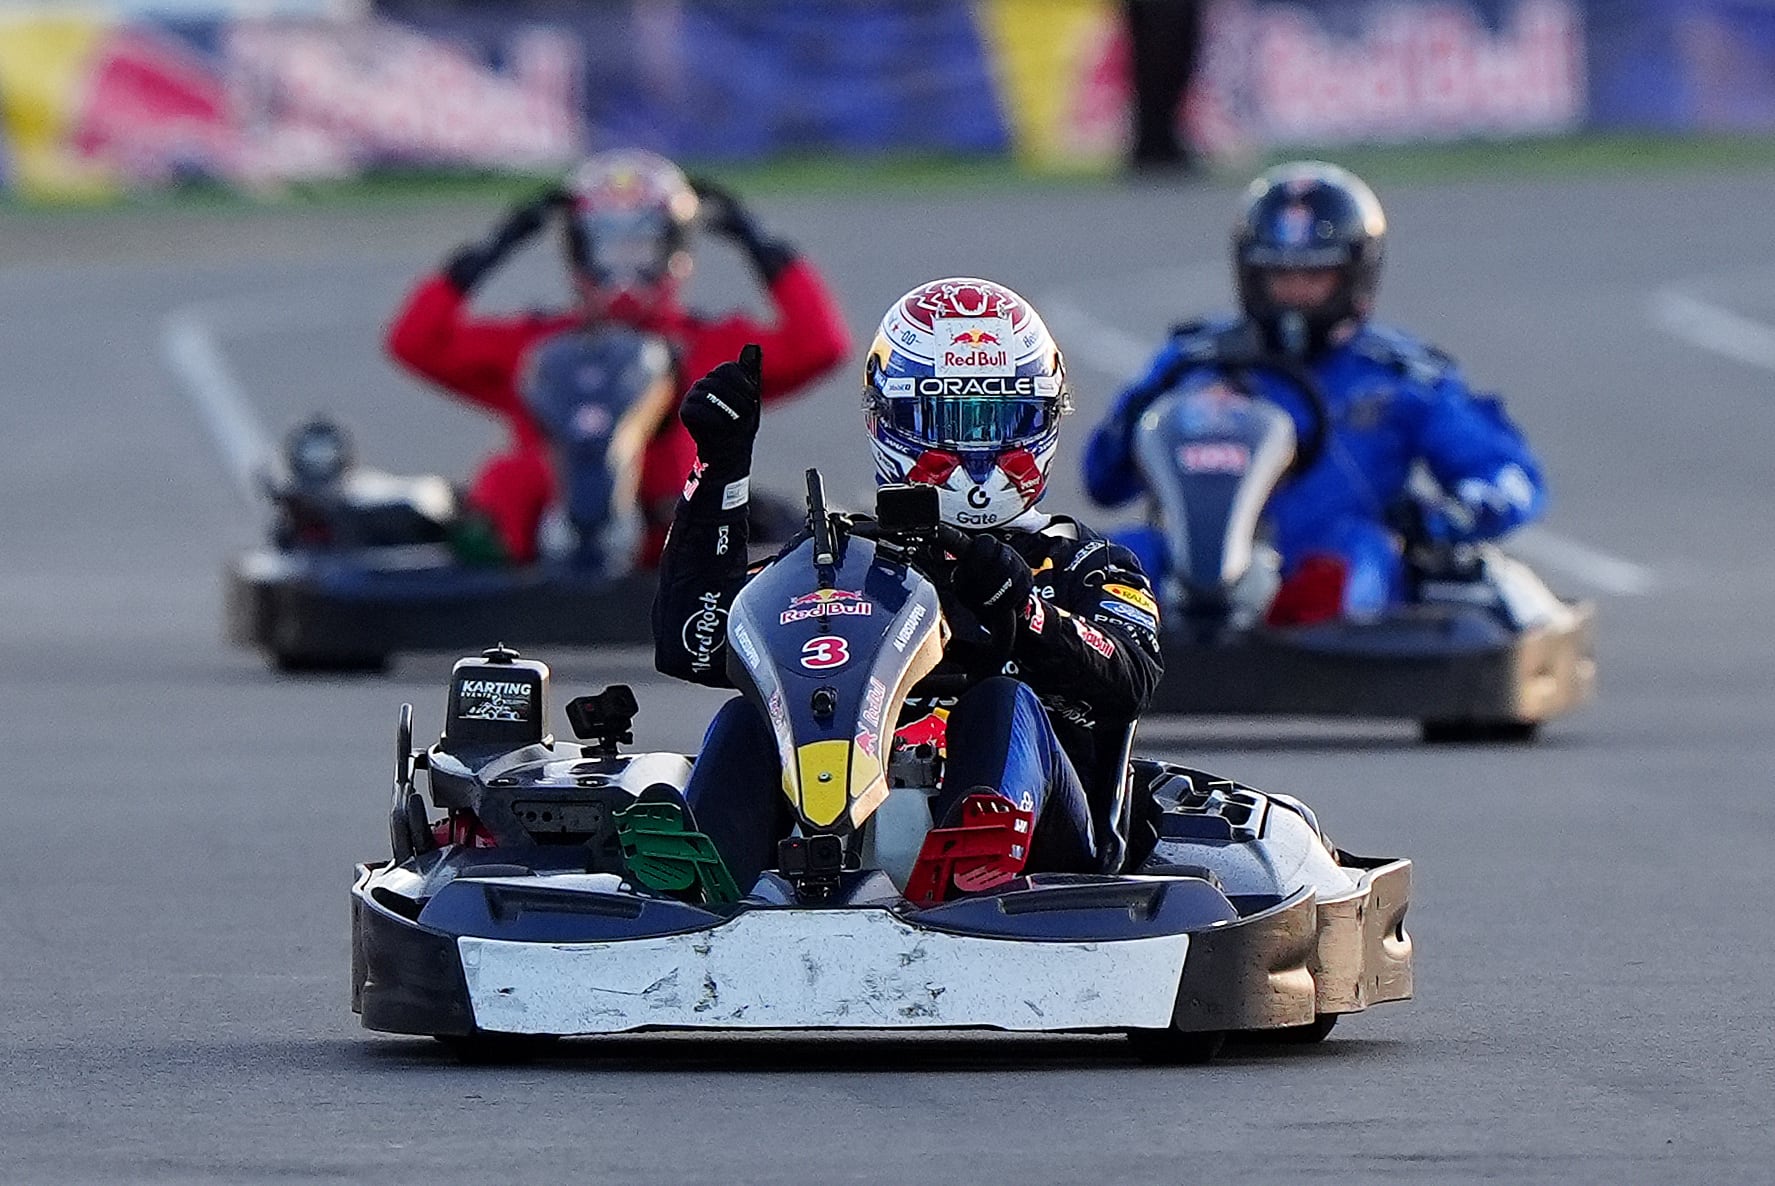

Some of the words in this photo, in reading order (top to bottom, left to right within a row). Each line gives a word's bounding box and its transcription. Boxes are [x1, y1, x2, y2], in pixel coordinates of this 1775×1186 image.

[944, 351, 975, 366] Red
[978, 351, 1007, 366] Bull
[919, 379, 1032, 395] ORACLE
[956, 511, 997, 524] Gate
[698, 591, 721, 633] Rock
[780, 603, 826, 625] Red
[826, 602, 872, 616] Bull
[691, 633, 713, 673] Hard
[801, 636, 849, 669] 3
[462, 680, 532, 695] KARTING
